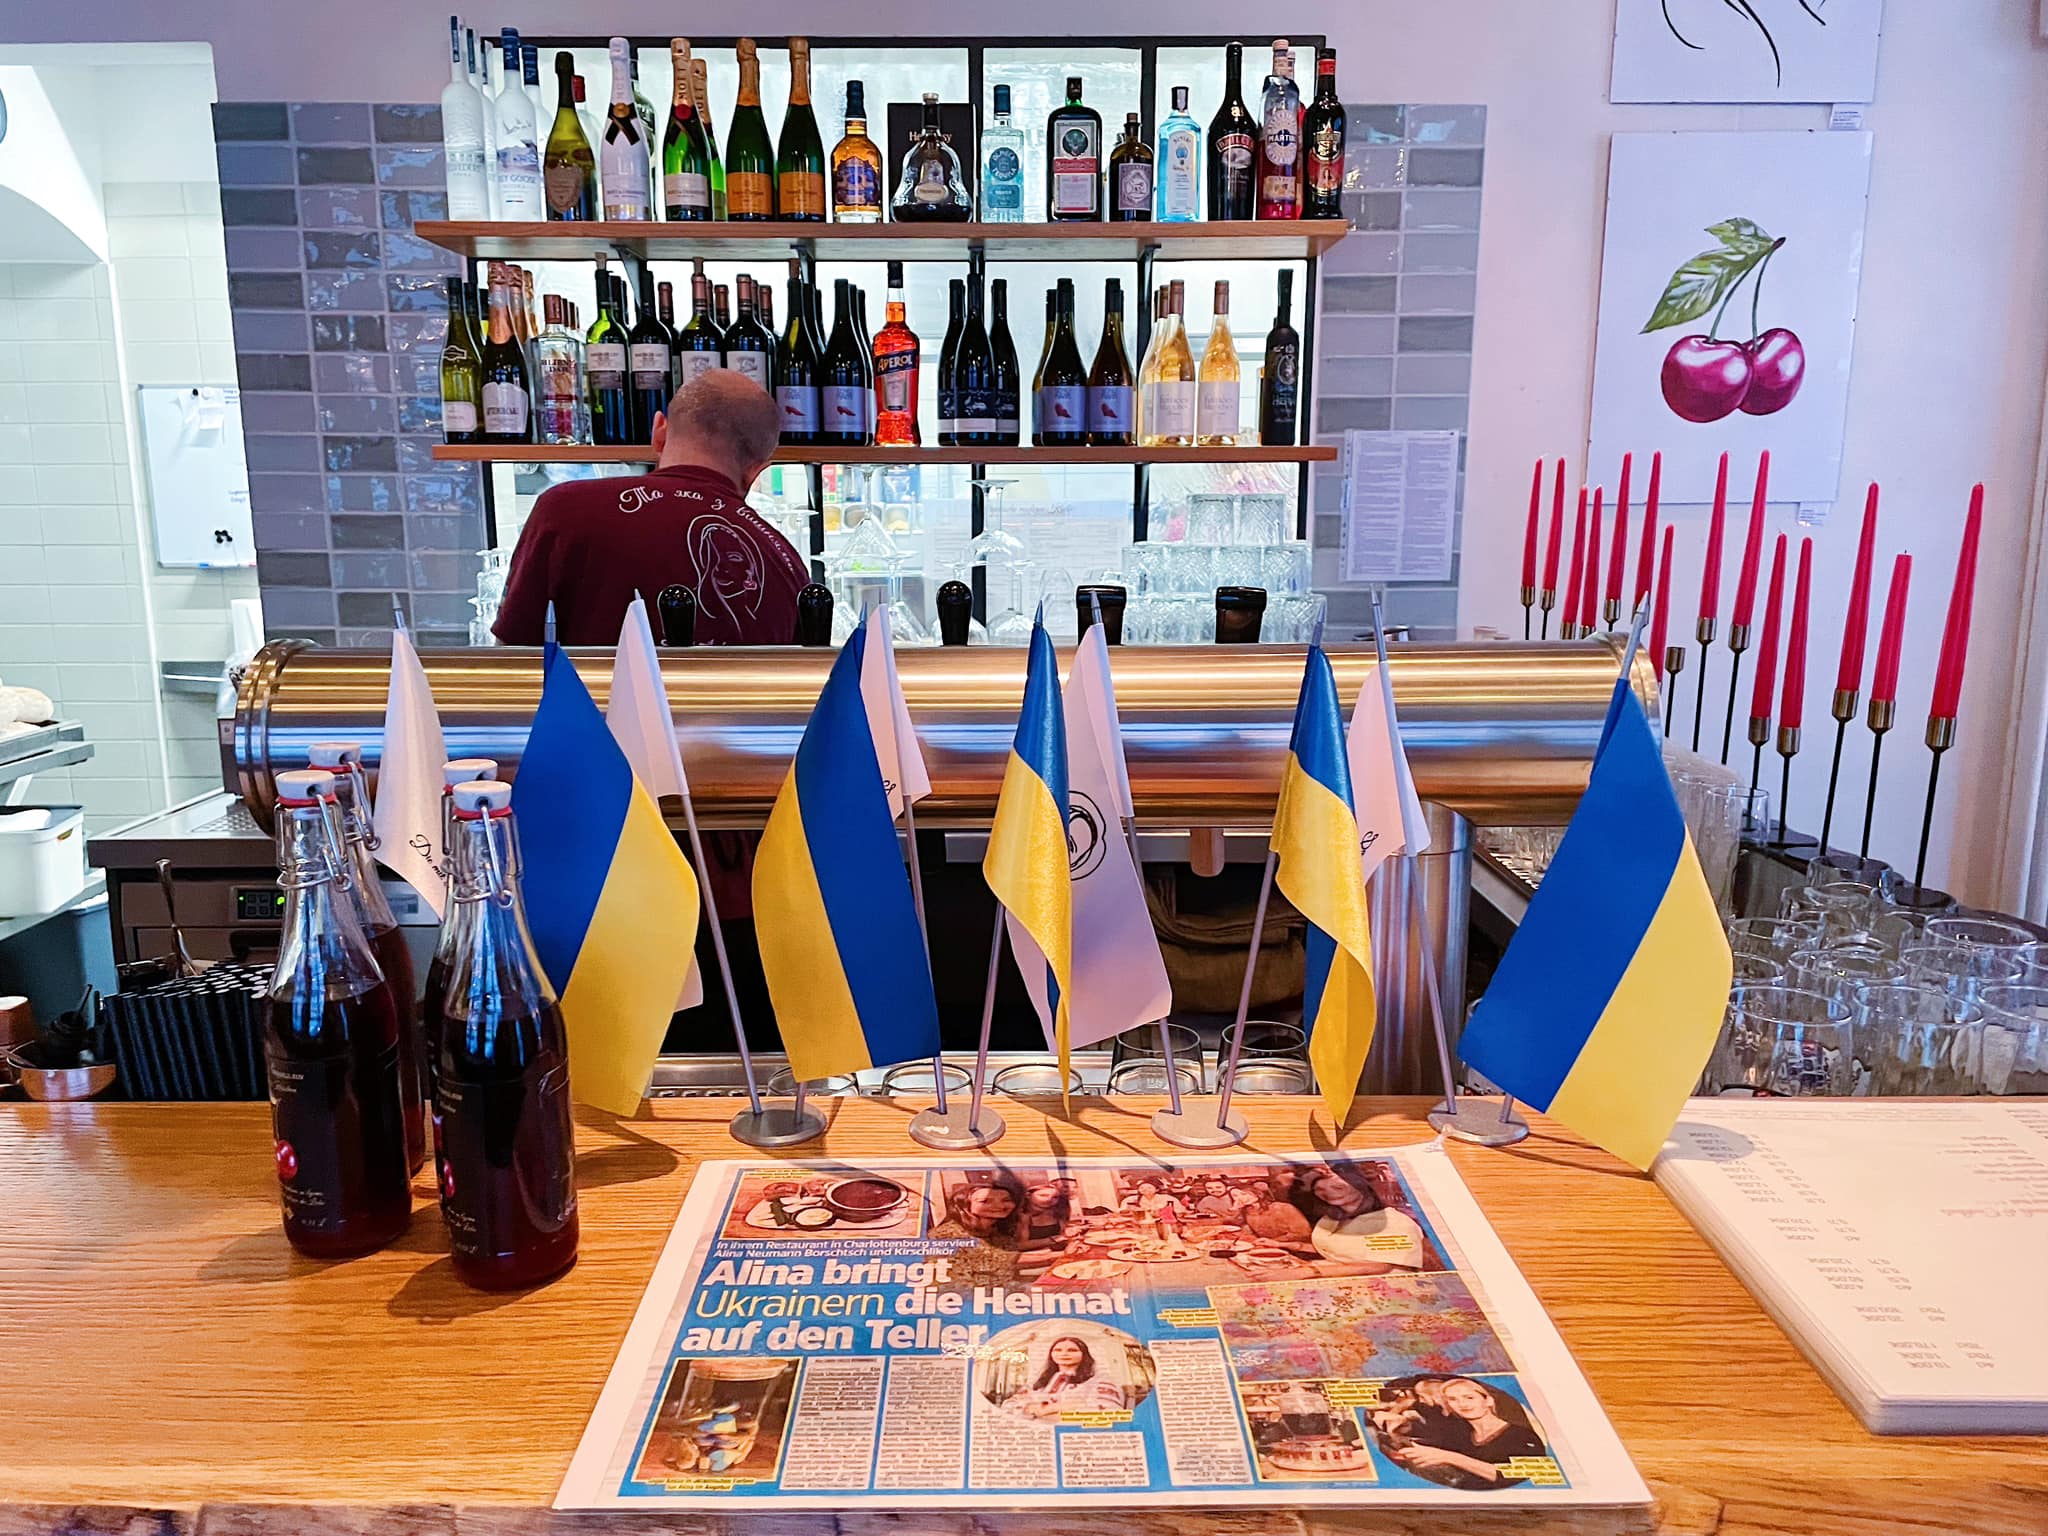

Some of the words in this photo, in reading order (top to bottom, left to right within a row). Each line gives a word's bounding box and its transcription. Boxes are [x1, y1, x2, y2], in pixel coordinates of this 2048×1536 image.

[878, 354, 913, 372] APEROL
[713, 1249, 744, 1258] Alina
[745, 1249, 801, 1257] Neumann
[804, 1248, 866, 1257] Borschtsch
[869, 1248, 892, 1257] und
[894, 1247, 955, 1256] Kirschlikör
[717, 1241, 729, 1250] In
[730, 1241, 763, 1250] ihrem
[765, 1240, 829, 1249] Restaurant
[831, 1240, 841, 1249] in
[843, 1239, 930, 1249] Charlottenburg
[932, 1240, 975, 1248] serviert
[702, 1258, 815, 1287] Alina
[822, 1257, 953, 1288] bringt
[695, 1289, 885, 1318] Ukrainern
[895, 1286, 964, 1316] die
[973, 1286, 1131, 1316] Heimat
[681, 1320, 762, 1352] auf
[766, 1319, 854, 1351] den
[865, 1318, 988, 1351] Teller
